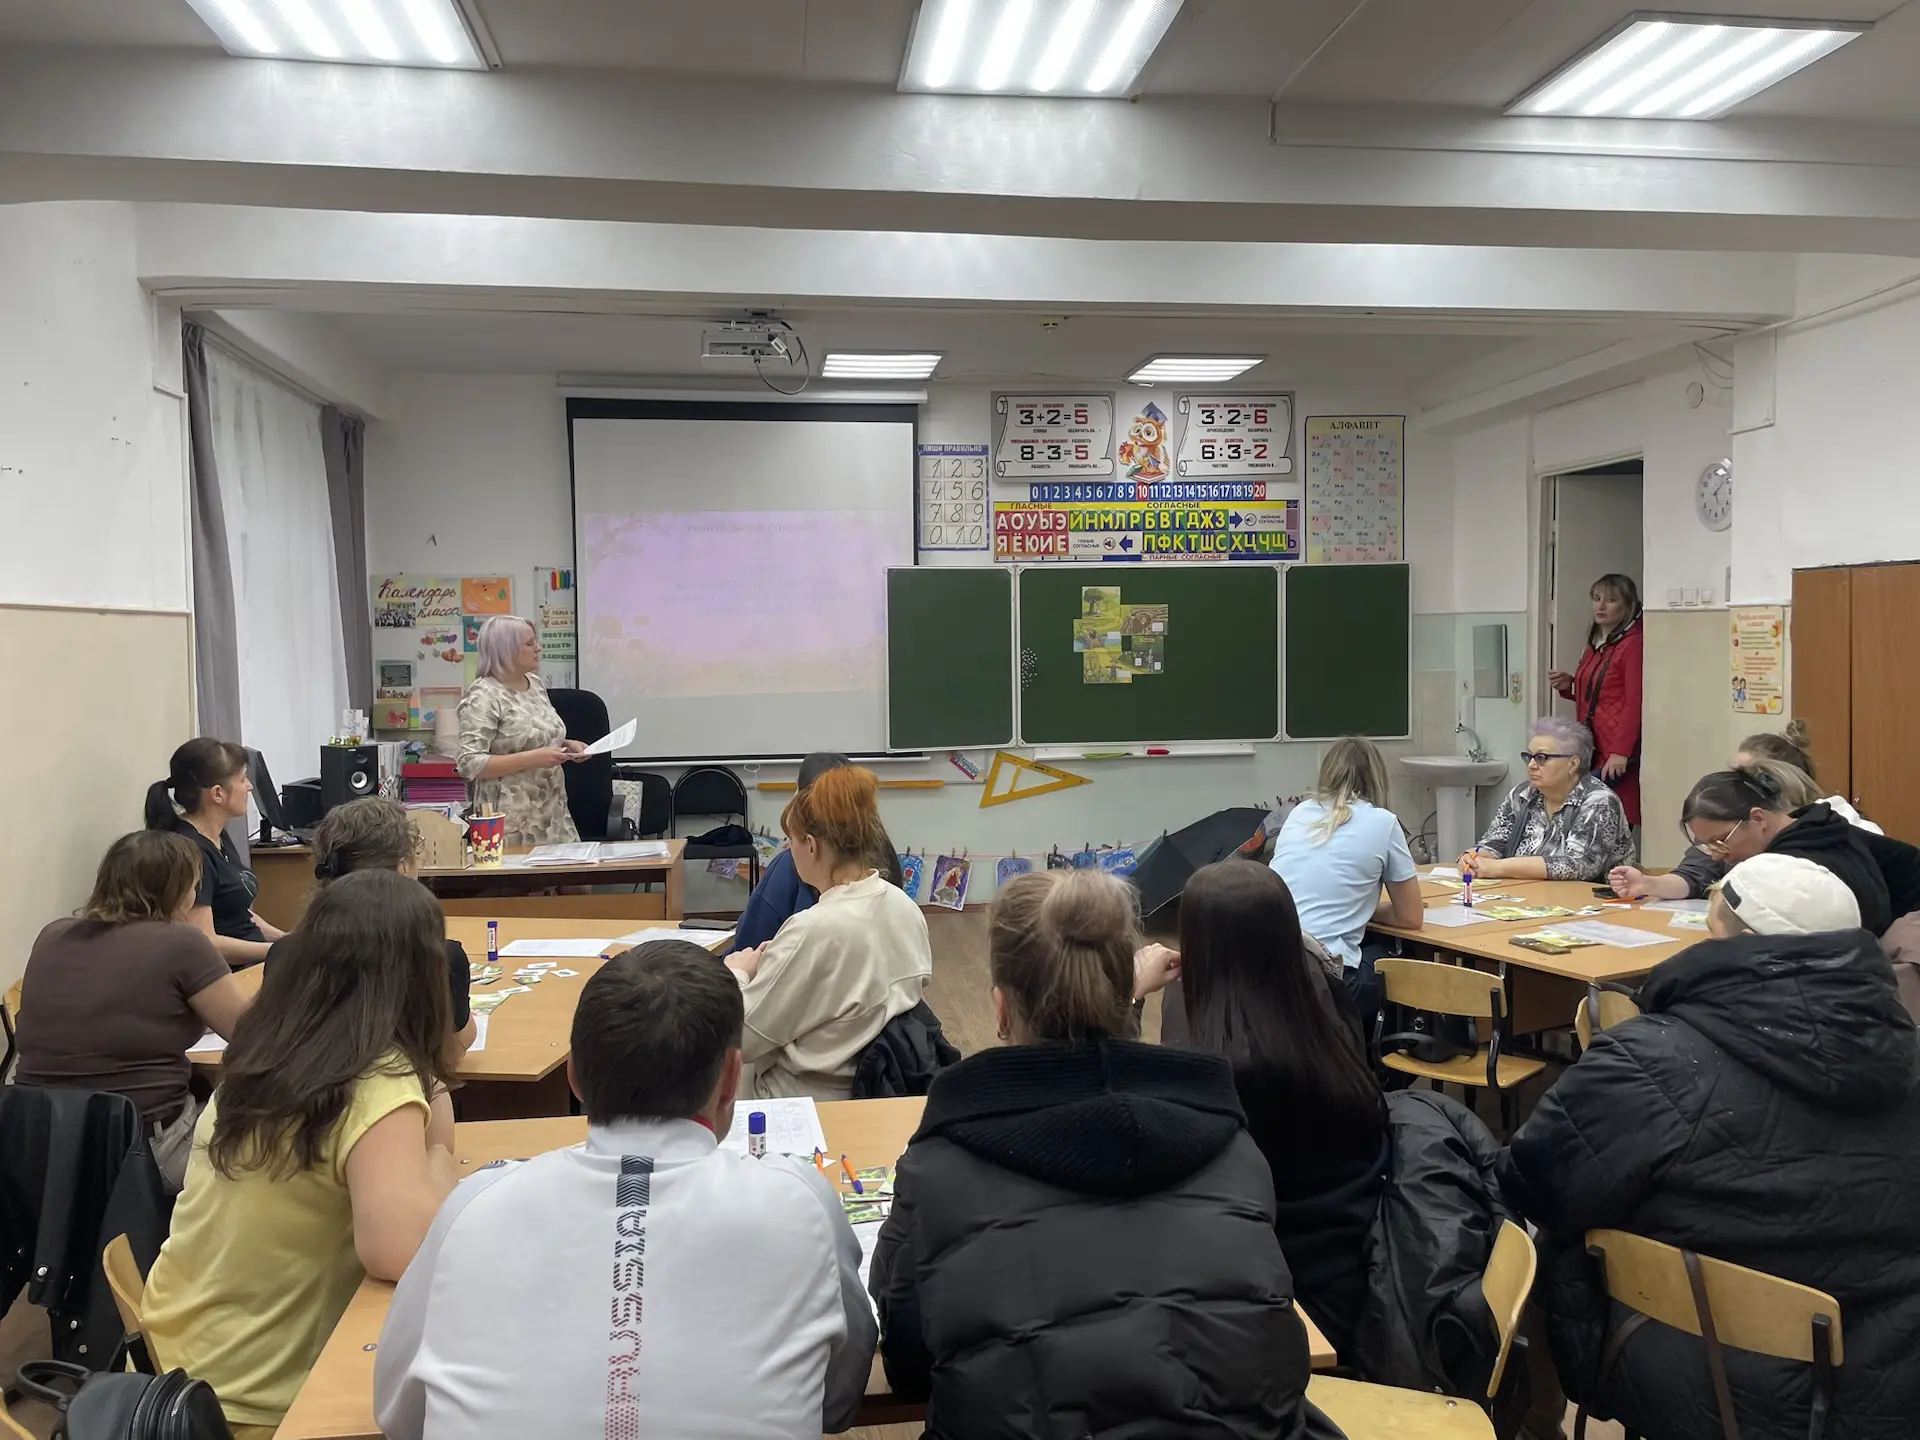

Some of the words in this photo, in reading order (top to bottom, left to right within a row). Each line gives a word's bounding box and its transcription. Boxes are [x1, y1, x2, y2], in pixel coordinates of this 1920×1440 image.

[1330, 421, 1380, 430] АЛФАВИТ
[933, 459, 941, 478] 1
[951, 459, 962, 478] 2
[972, 459, 983, 478] 3
[932, 481, 941, 499] 4
[951, 481, 962, 500] 5
[972, 481, 983, 500] 6
[1032, 486, 1039, 499] 0
[1044, 486, 1048, 499] 1
[1054, 486, 1060, 499] 2
[1064, 486, 1070, 499] 3
[1075, 486, 1081, 499] 4
[1086, 486, 1092, 499] 5
[1096, 486, 1103, 499] 6
[1107, 486, 1113, 499] 7
[1117, 485, 1124, 498] 8
[1128, 485, 1134, 498] 9
[1138, 485, 1147, 498] 10
[1150, 485, 1158, 498] 11
[1161, 485, 1171, 498] 12
[1173, 485, 1183, 498] 13
[1185, 485, 1195, 498] 14
[1197, 485, 1206, 498] 15
[1209, 485, 1219, 498] 16
[1220, 485, 1230, 498] 17
[1232, 485, 1242, 498] 18
[1244, 485, 1253, 498] 19
[1255, 485, 1265, 498] 20
[931, 503, 941, 522] 7
[951, 503, 963, 522] 8
[972, 503, 984, 522] 9
[930, 526, 942, 544] 0
[956, 526, 982, 544] 10
[378, 579, 456, 606] Календарь
[606, 1209, 647, 1404] RUSSIA
